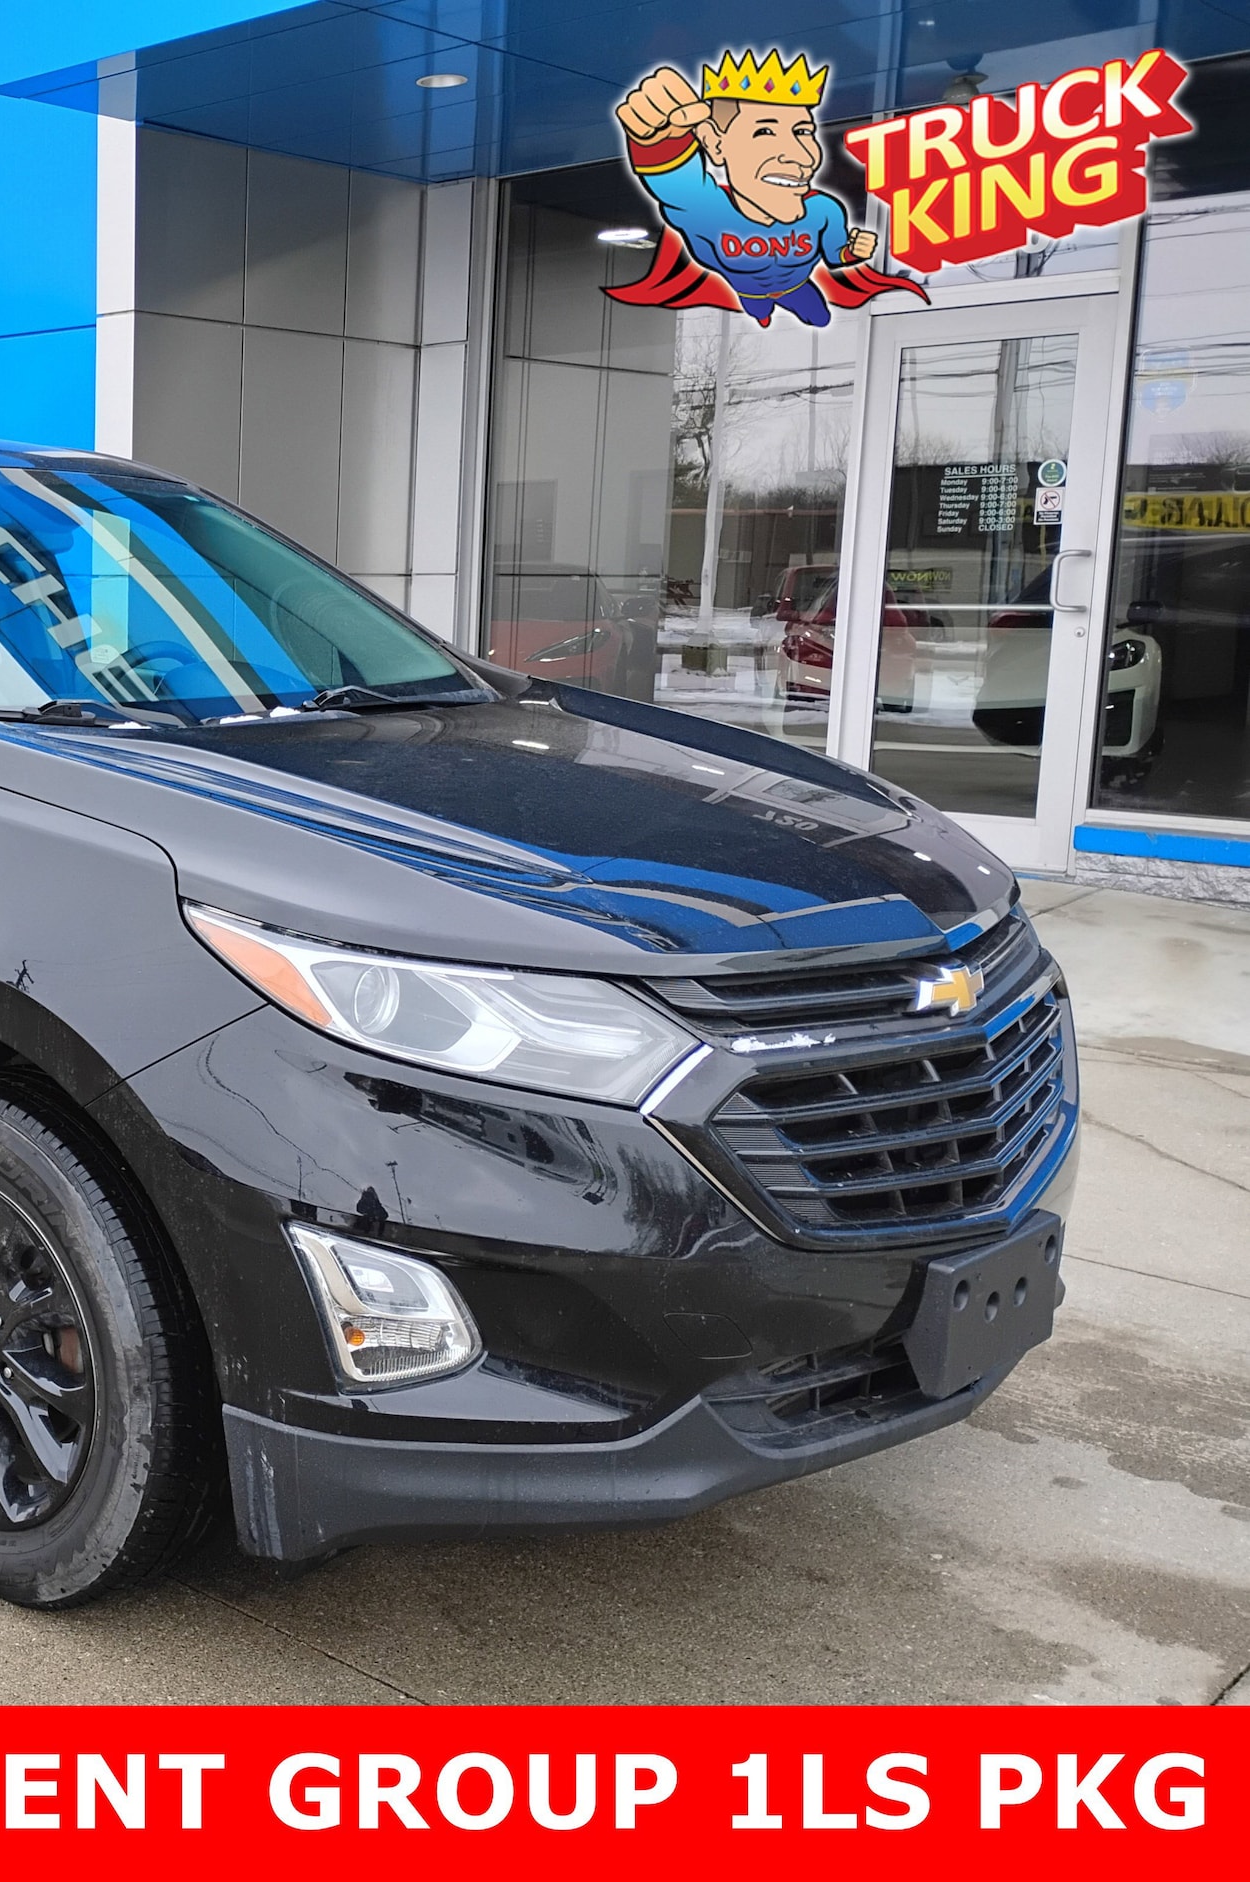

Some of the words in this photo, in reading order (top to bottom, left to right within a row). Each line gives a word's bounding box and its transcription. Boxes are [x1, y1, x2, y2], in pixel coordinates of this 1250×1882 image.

[944, 466, 978, 476] SALES
[980, 464, 1017, 474] HOURS
[981, 477, 1018, 485] 9:00-7:00
[940, 486, 968, 494] Tuesday
[938, 510, 960, 518] Friday
[937, 517, 968, 525] Saturday
[936, 525, 963, 533] Sunday
[978, 523, 1014, 532] CLOSED
